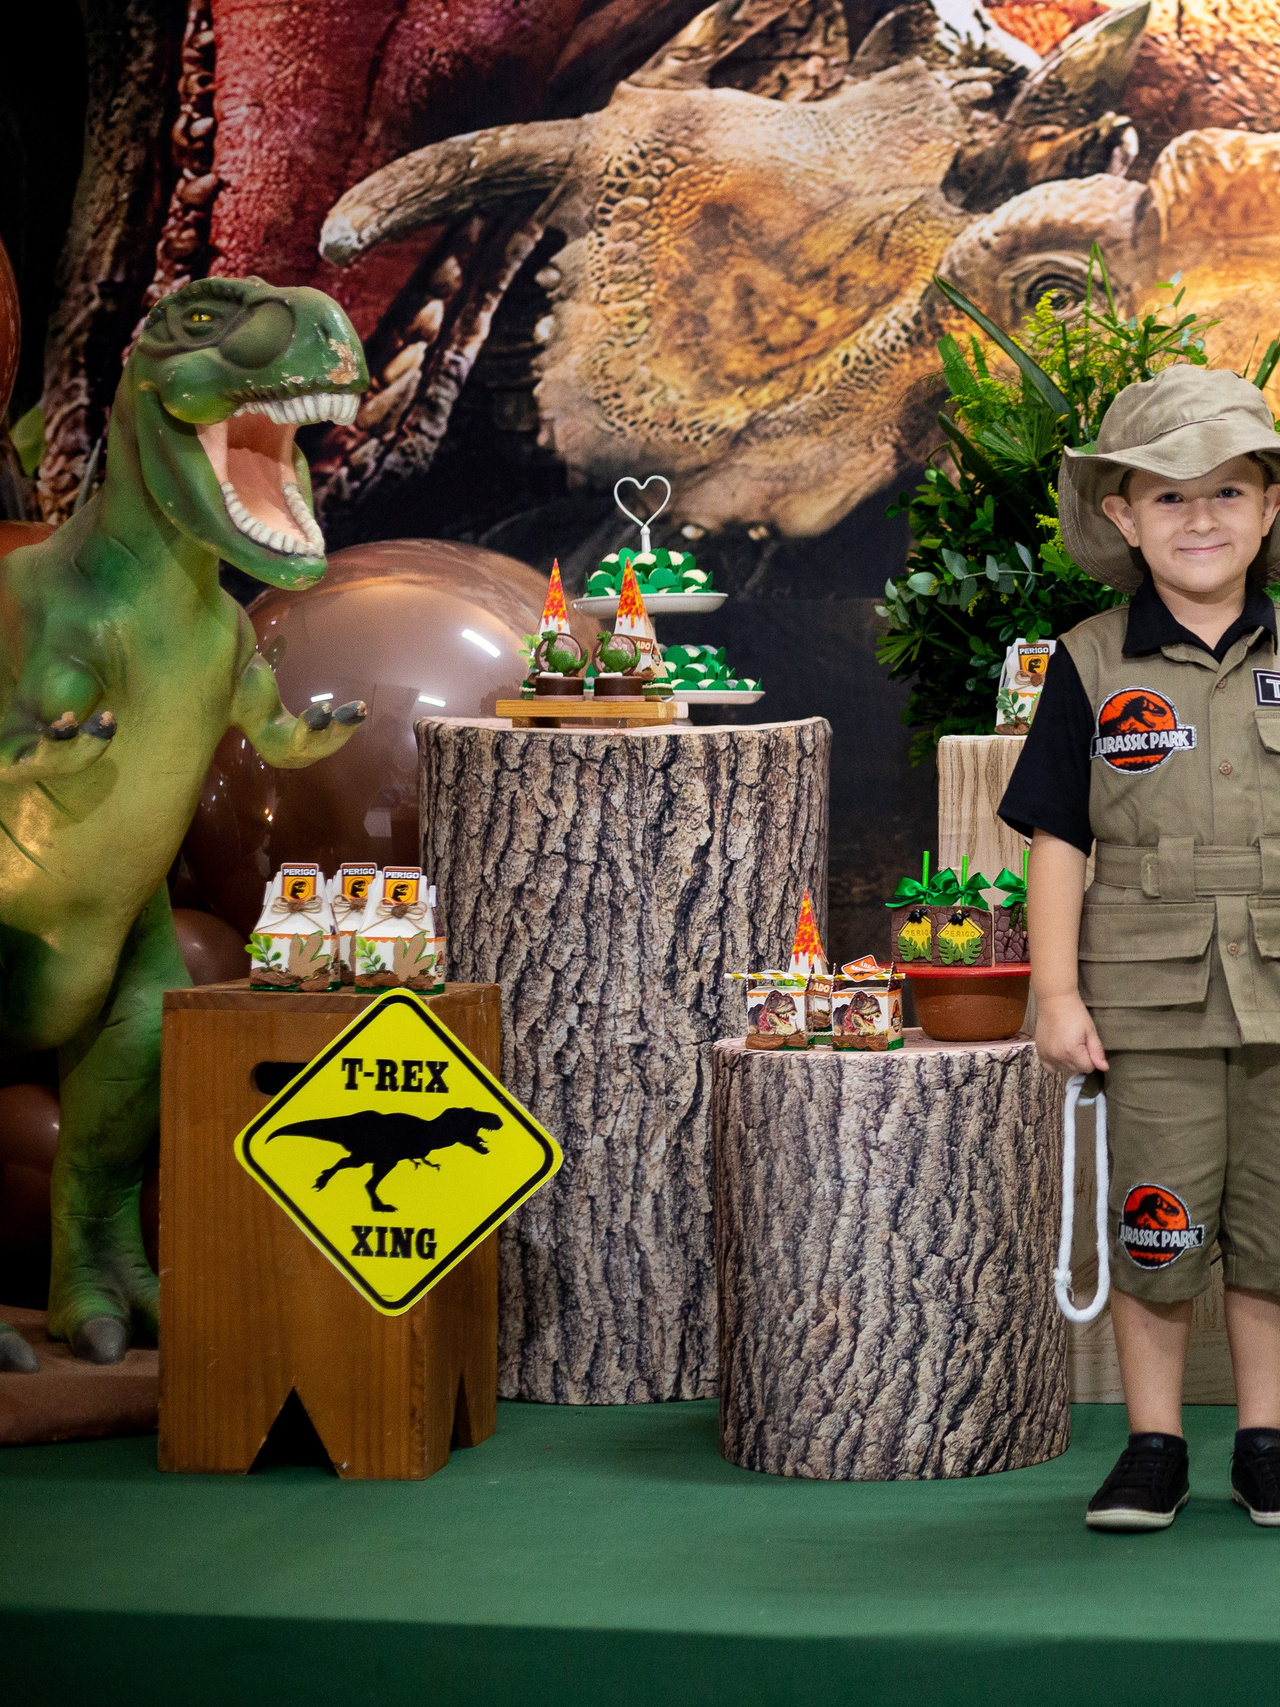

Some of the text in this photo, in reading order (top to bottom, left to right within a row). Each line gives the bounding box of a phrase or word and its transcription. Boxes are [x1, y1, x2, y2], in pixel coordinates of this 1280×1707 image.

[1019, 647, 1049, 655] PERIGO
[1095, 730, 1190, 755] JURASSIC PARK
[282, 868, 317, 876] PERIGO
[342, 867, 375, 875] PERIGO
[385, 871, 420, 879] PERIGO
[906, 929, 931, 937] PERIG
[944, 929, 976, 938] PERIGO
[341, 1057, 449, 1094] T-REX
[1120, 1224, 1200, 1248] JURASSIC PARK
[351, 1224, 437, 1260] XING
